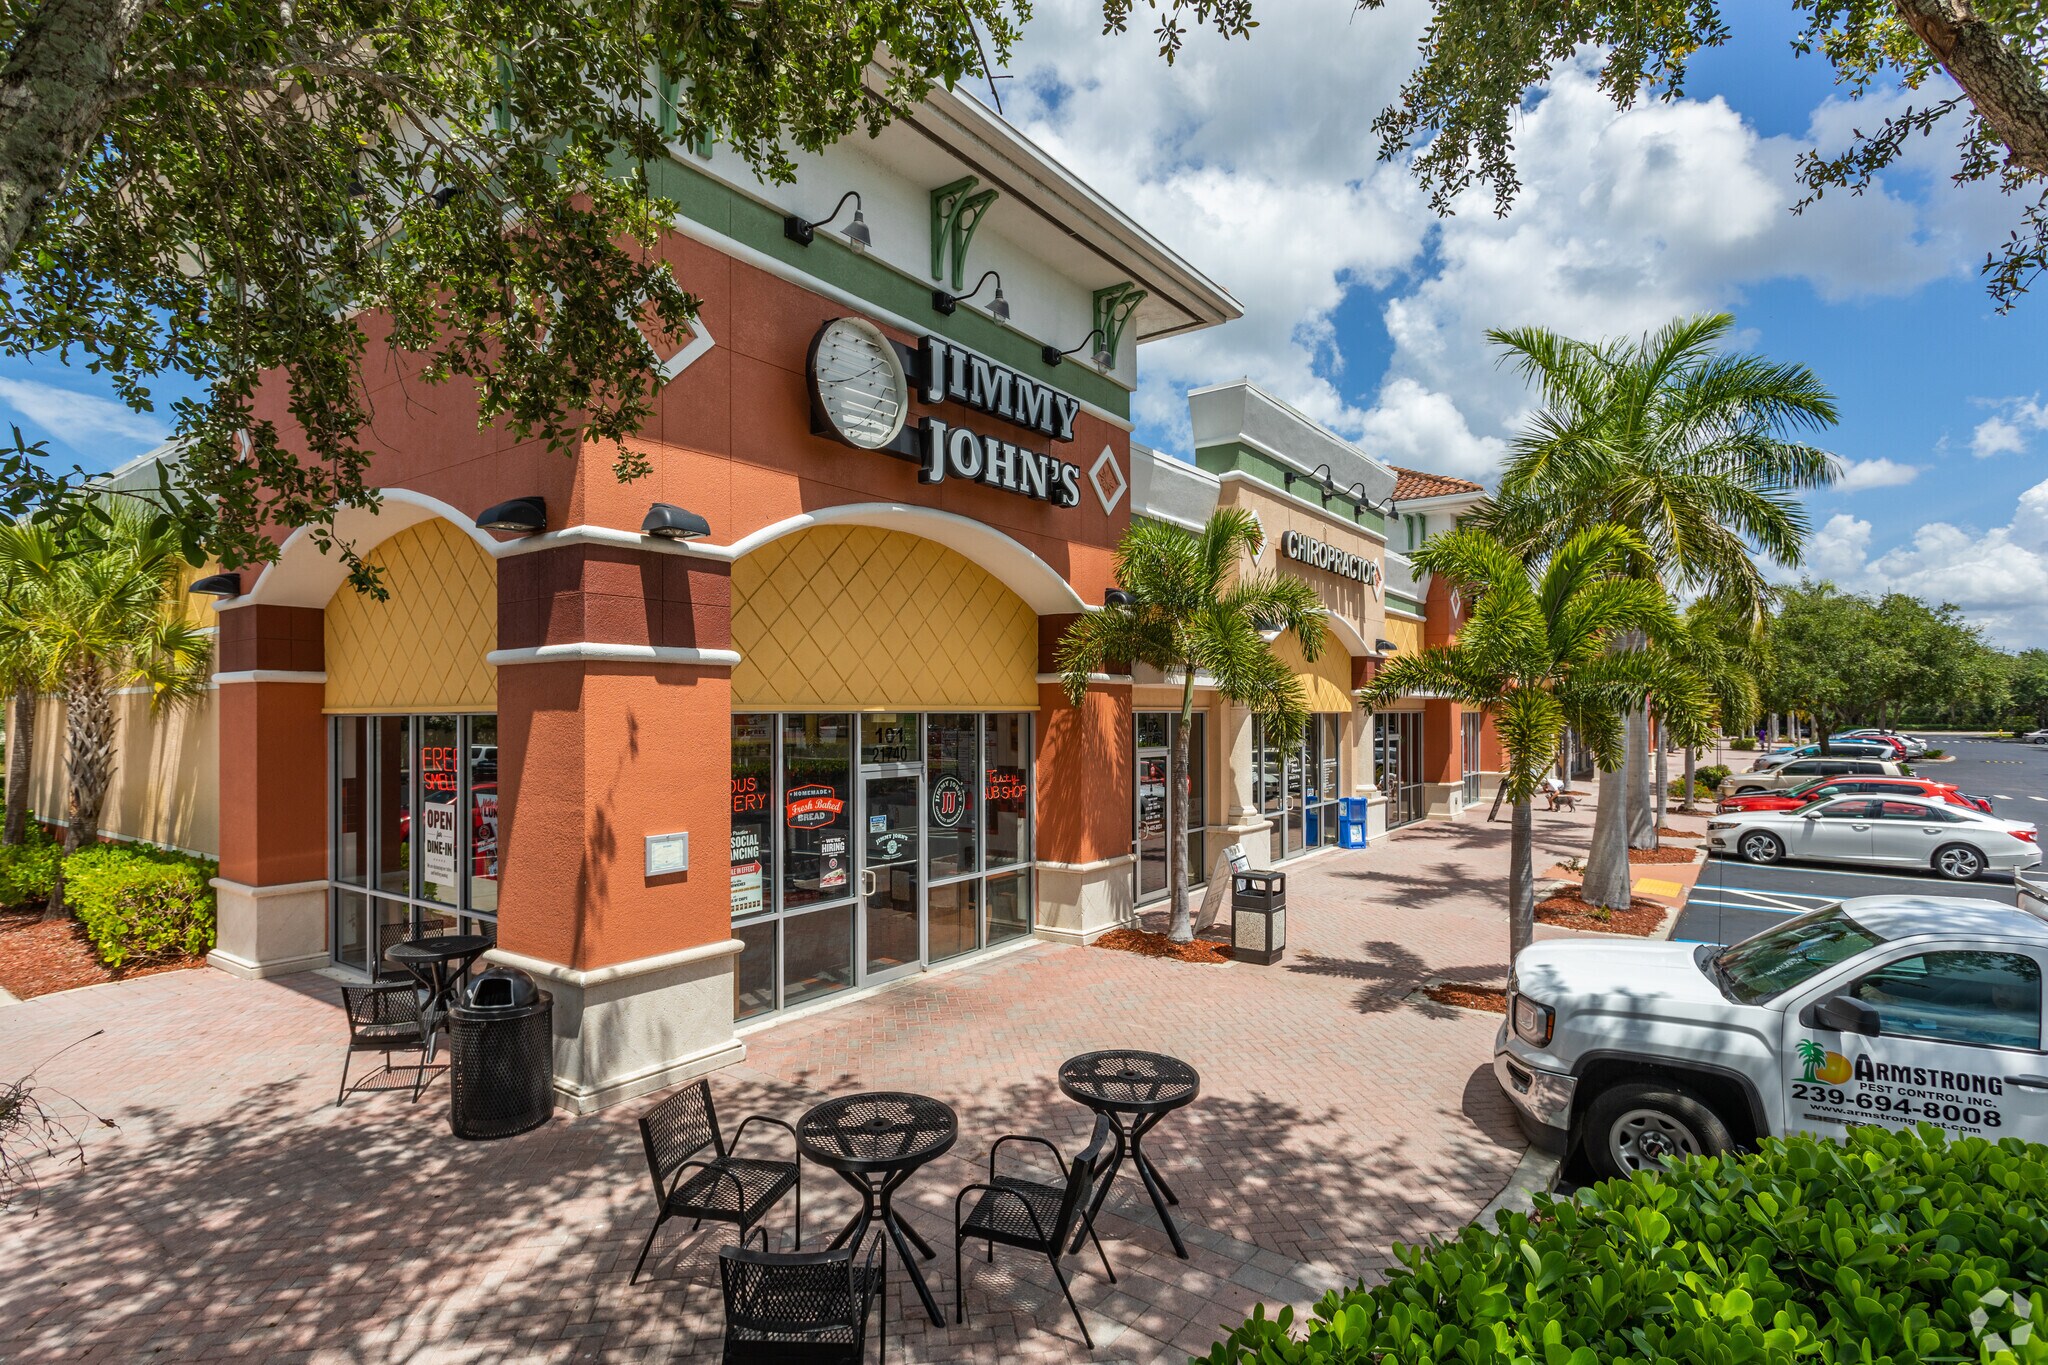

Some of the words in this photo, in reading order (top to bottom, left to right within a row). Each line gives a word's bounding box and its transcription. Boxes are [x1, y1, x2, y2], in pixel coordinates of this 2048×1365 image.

[921, 335, 1080, 442] JIMMY
[920, 417, 1081, 507] JOHN'S
[1283, 530, 1376, 585] CHIROPRACTOR
[875, 727, 904, 743] 101
[872, 746, 907, 763] 21740
[986, 769, 1019, 785] Tasty
[1001, 784, 1027, 799] SHOP
[733, 793, 766, 812] ERY
[791, 799, 813, 816] Fresh
[814, 798, 841, 811] Baked
[941, 791, 956, 814] JJ
[427, 809, 452, 831] OPEN
[797, 812, 826, 821] BREAD
[427, 840, 452, 857] DINE-IN
[731, 834, 759, 849] SOCIAL
[821, 842, 845, 853] HIRING
[736, 867, 742, 875] IN
[741, 865, 755, 874] EFFECT
[1855, 1053, 2003, 1096] ARMSTRONG
[1860, 1082, 1893, 1094] PEST
[1897, 1086, 1963, 1104] CONTROL
[1967, 1096, 1997, 1108] INC.
[1791, 1083, 2002, 1128] 239-694-8008
[1803, 1113, 1883, 1129] SIERR
[1810, 1103, 1981, 1134] www.armstrongst.com
